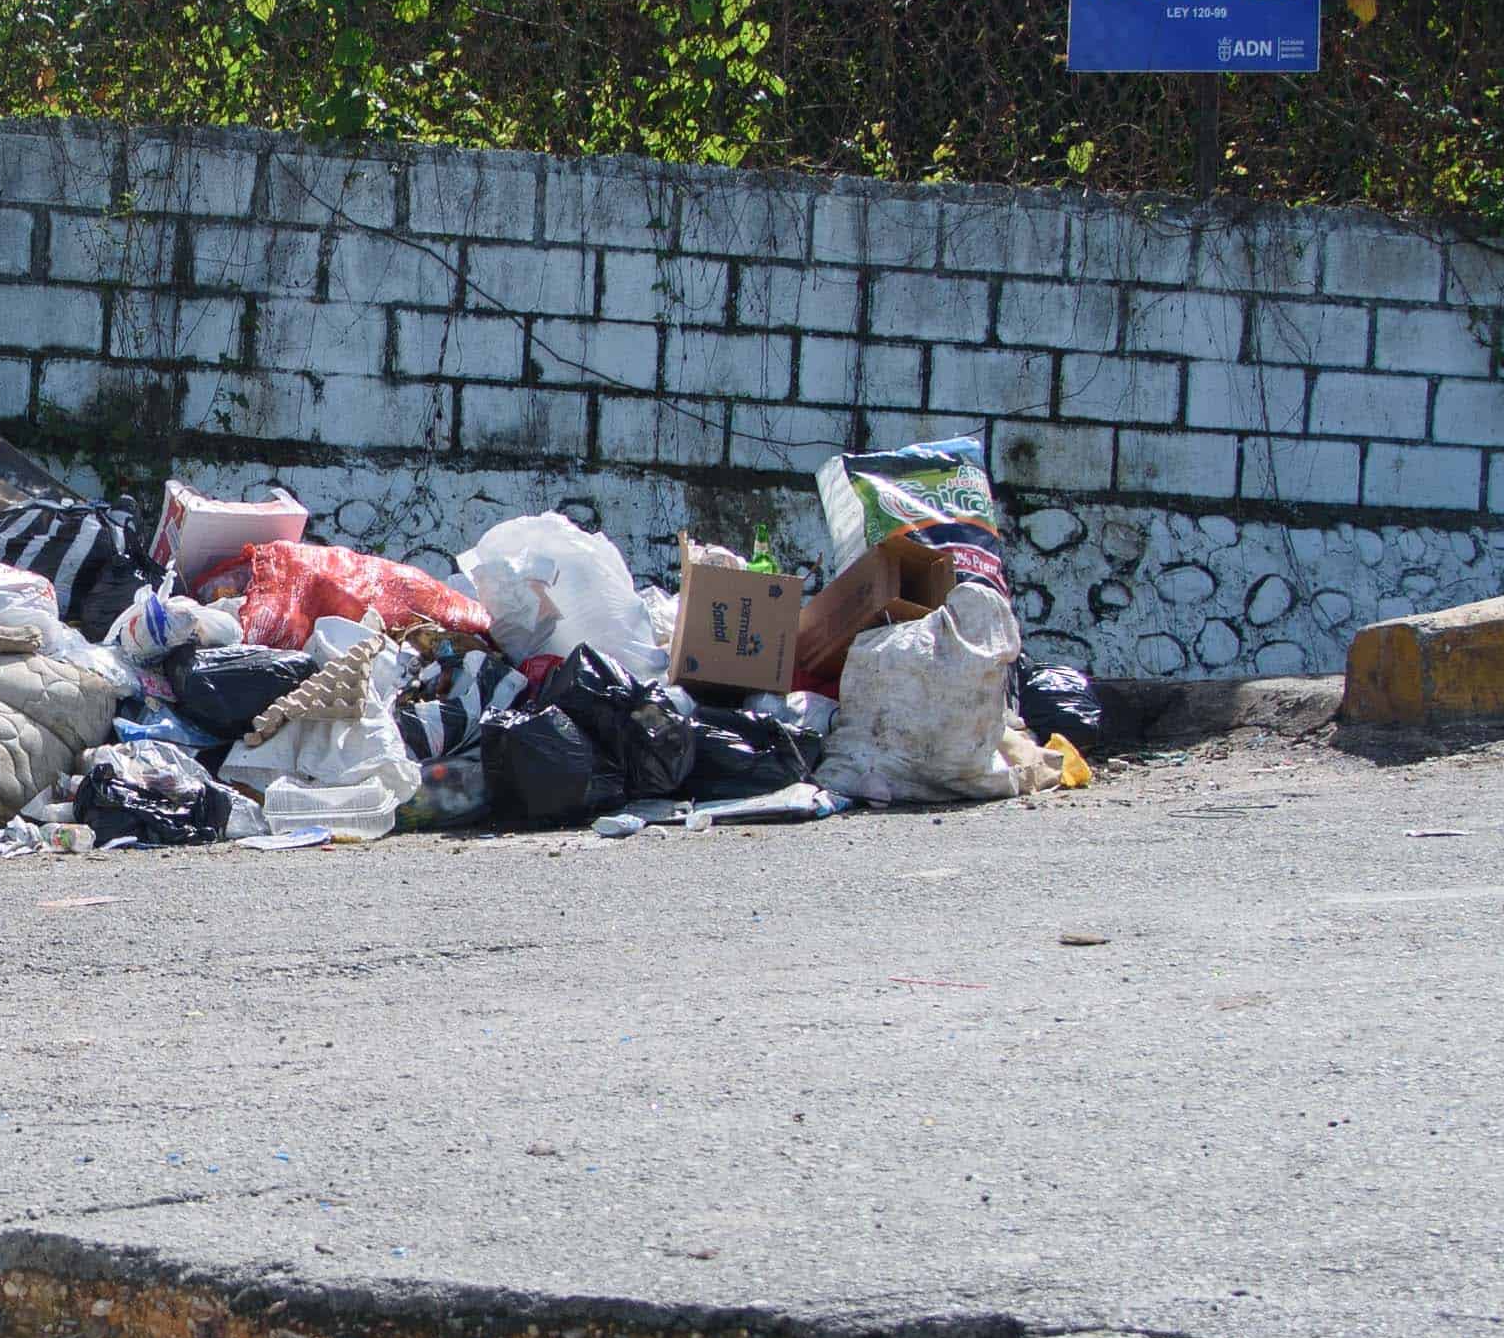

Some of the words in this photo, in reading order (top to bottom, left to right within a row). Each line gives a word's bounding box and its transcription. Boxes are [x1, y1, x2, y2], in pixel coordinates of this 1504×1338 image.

[1166, 7, 1189, 18] LEY
[1192, 7, 1228, 18] 120-99
[1233, 40, 1273, 57] ADN
[736, 597, 752, 656] parmalat
